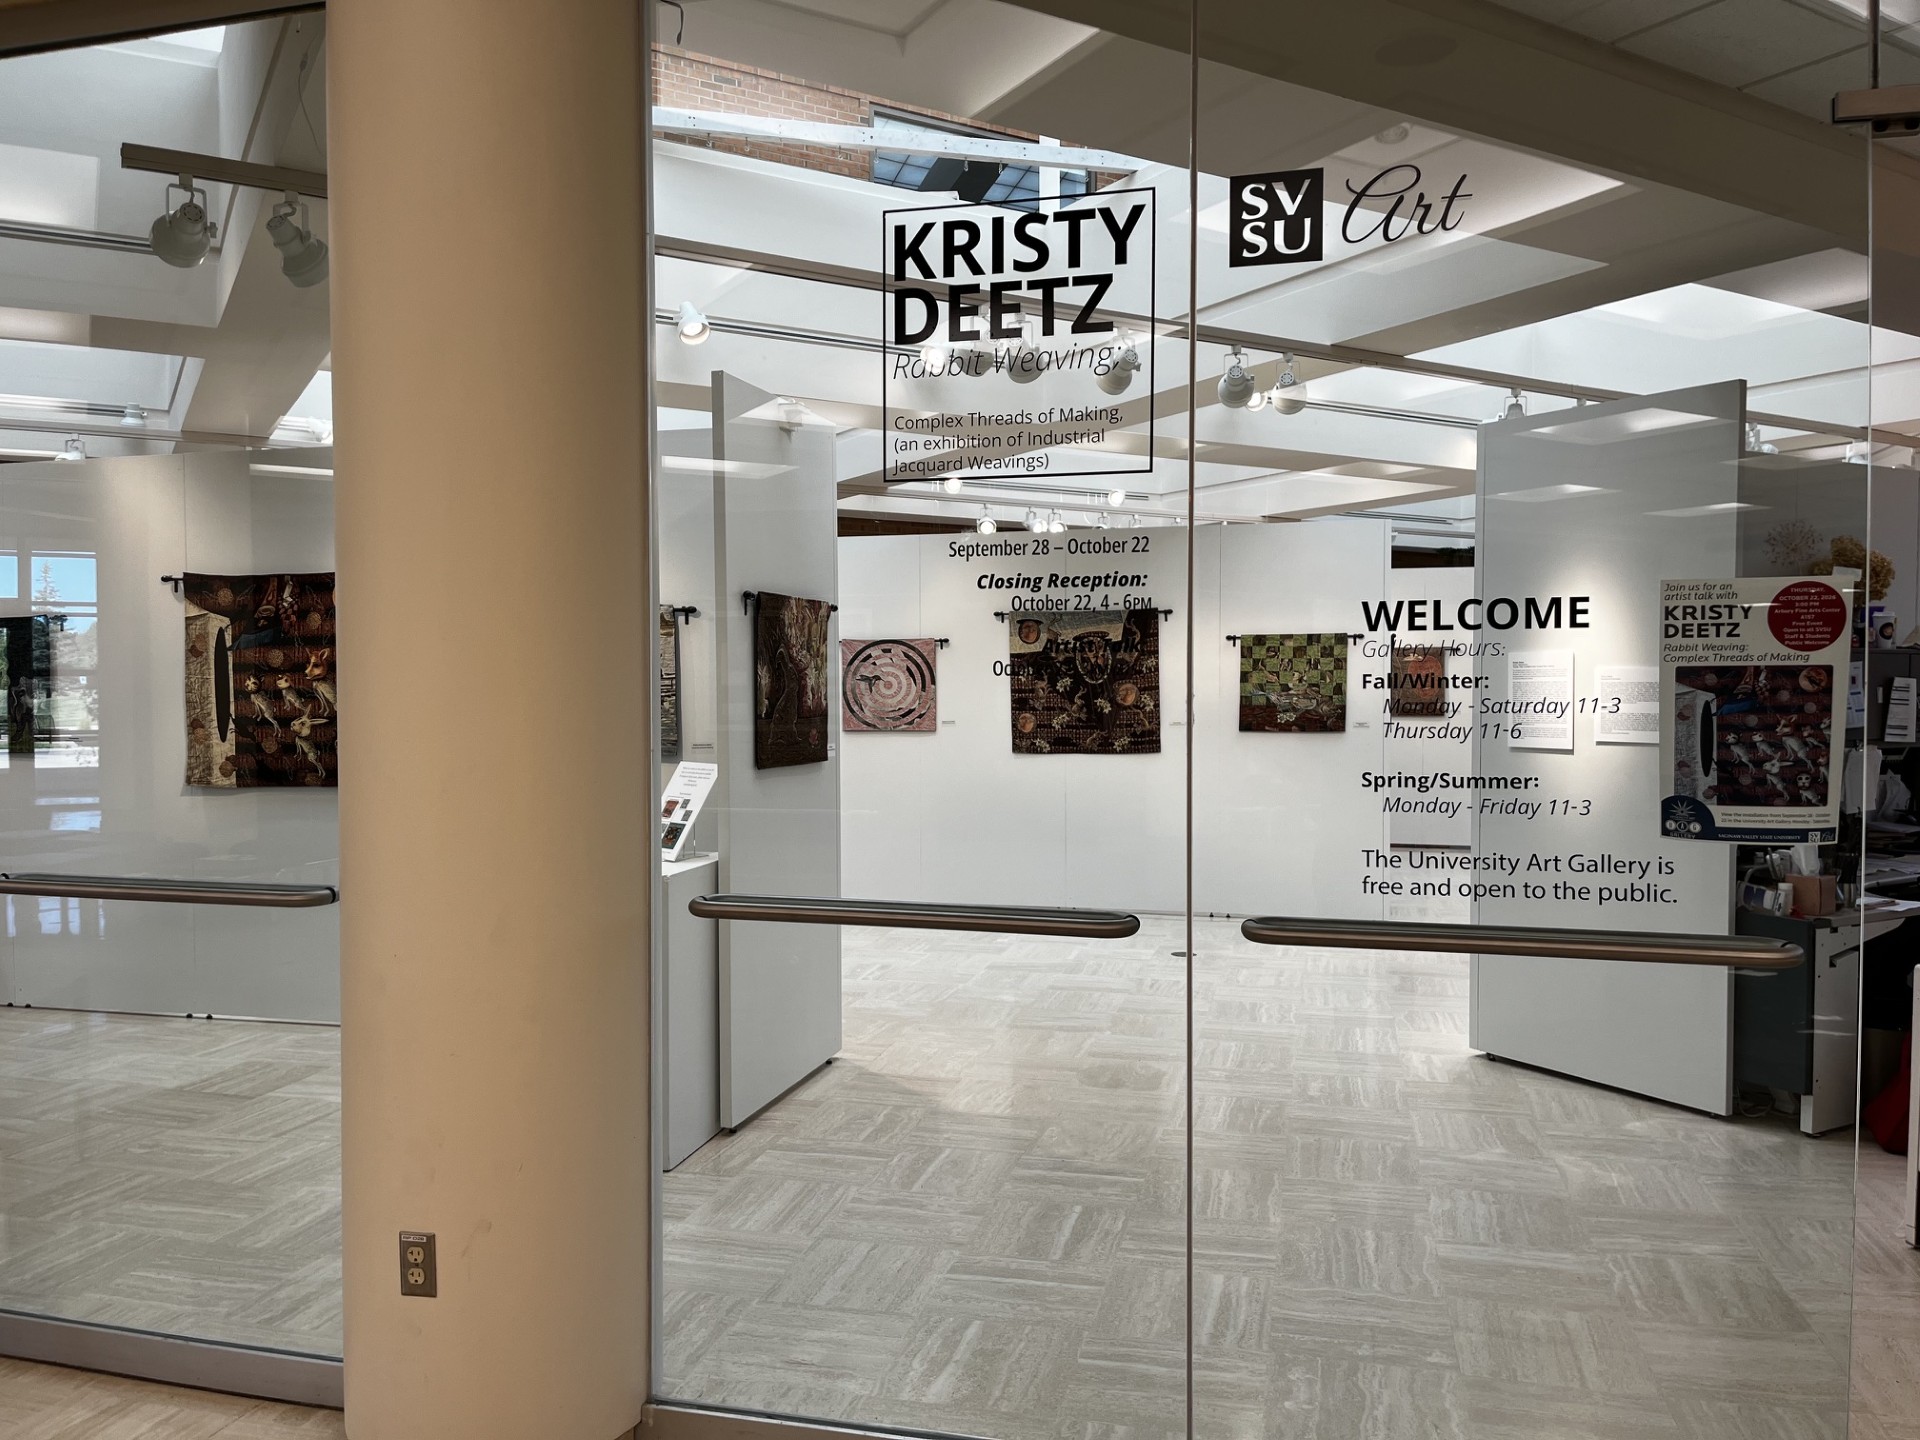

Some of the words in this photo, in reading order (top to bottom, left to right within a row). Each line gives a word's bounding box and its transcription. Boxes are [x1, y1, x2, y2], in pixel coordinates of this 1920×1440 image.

[1341, 164, 1473, 243] Art
[893, 203, 1146, 281] KRISTY
[894, 273, 1114, 345] DEETZ
[893, 349, 984, 380] Rabbit
[894, 413, 963, 432] Complex
[967, 408, 1033, 428] Threads
[1038, 408, 1055, 424] of
[1059, 405, 1124, 423] Making,
[894, 437, 918, 454] (an
[923, 432, 1001, 451] exhibition
[1006, 430, 1024, 448] of
[1028, 428, 1105, 447] Industrial
[893, 456, 963, 476] Jacquard
[967, 452, 1049, 472] Weavings)
[948, 538, 1028, 562] September
[1031, 539, 1050, 556] 28
[1067, 536, 1128, 555] October
[1131, 536, 1150, 553] 22
[976, 572, 1043, 593] Closing
[1047, 570, 1148, 592] Reception:
[1664, 583, 1686, 592] Join
[1702, 583, 1717, 591] for
[1011, 594, 1070, 612] October
[1073, 594, 1096, 613] 22,
[1100, 594, 1110, 611] 4
[1123, 593, 1152, 610] 6PM
[1664, 591, 1691, 601] artist
[1694, 591, 1714, 600] talk
[1716, 590, 1738, 600] with
[1361, 596, 1590, 632] WELCOME
[1664, 604, 1753, 620] KRISTY
[1663, 622, 1741, 638] DEETZ
[1362, 639, 1433, 663] Gallery
[1440, 639, 1506, 657] Hours:
[1663, 643, 1698, 652] Rabbit
[1663, 653, 1710, 663] Complex
[1713, 653, 1754, 662] Threads
[1756, 652, 1768, 661] of
[1769, 652, 1810, 663] Making
[1361, 672, 1490, 690] Fall/Winter:
[1382, 697, 1462, 718] Monday
[1479, 697, 1571, 719] Saturday
[1578, 697, 1622, 714] 11-3
[1382, 722, 1473, 744] Thursday
[1480, 722, 1523, 740] 11-6
[1361, 771, 1540, 793] Spring/Summer:
[1382, 797, 1462, 819] Monday
[1479, 799, 1542, 820] Friday
[1550, 799, 1592, 816] 11-3
[1361, 849, 1402, 869] The
[1408, 850, 1520, 876] University
[1526, 852, 1562, 873] Art
[1567, 853, 1651, 880] Gallery
[1657, 855, 1675, 875] is
[1361, 875, 1403, 896] free
[1409, 878, 1451, 897] and
[1458, 882, 1517, 902] open
[1523, 881, 1547, 899] to
[1552, 881, 1591, 901] the
[1598, 882, 1678, 906] public.
